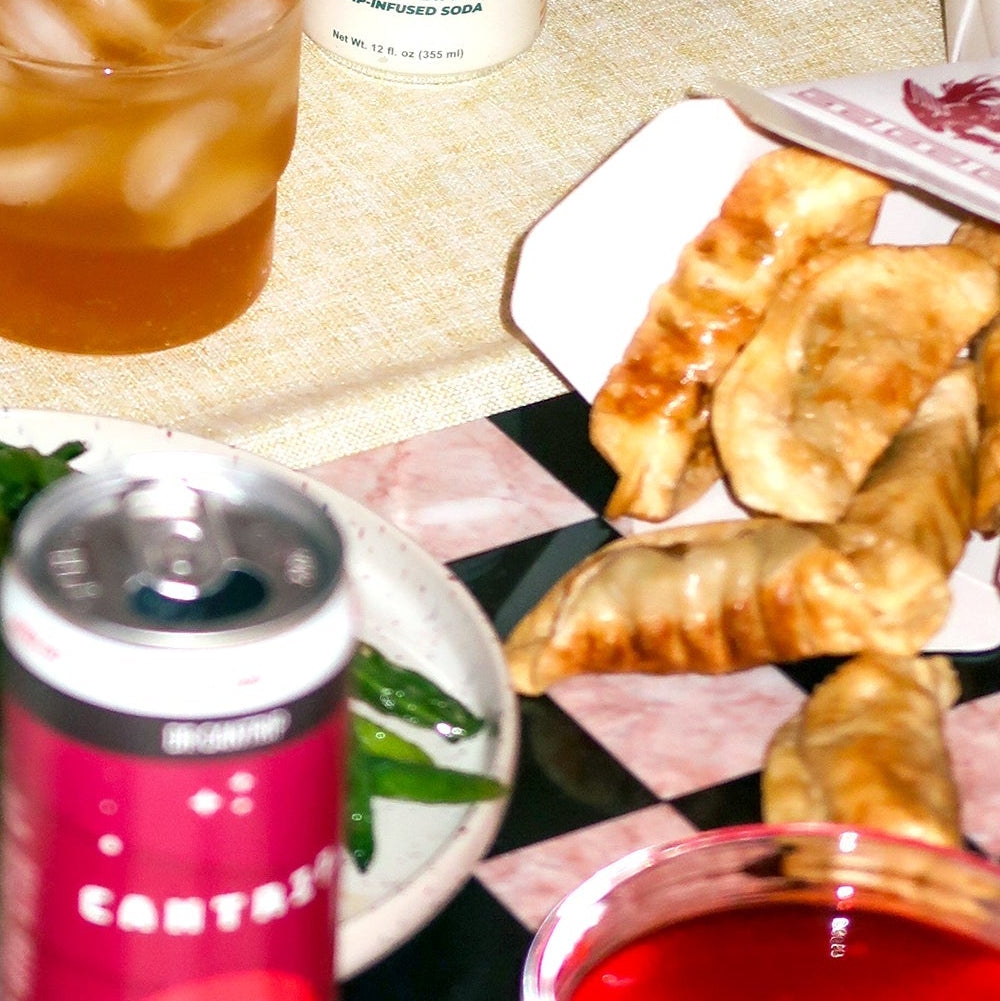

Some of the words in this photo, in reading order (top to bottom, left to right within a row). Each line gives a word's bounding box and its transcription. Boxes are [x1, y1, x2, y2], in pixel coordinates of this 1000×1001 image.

[440, 2, 483, 16] SODA
[332, 29, 349, 44] Net
[351, 36, 368, 50] Wt.
[371, 43, 384, 54] 12
[387, 46, 398, 56] fl.
[401, 50, 415, 58] oz
[418, 48, 443, 60] (355
[446, 48, 464, 59] ml)
